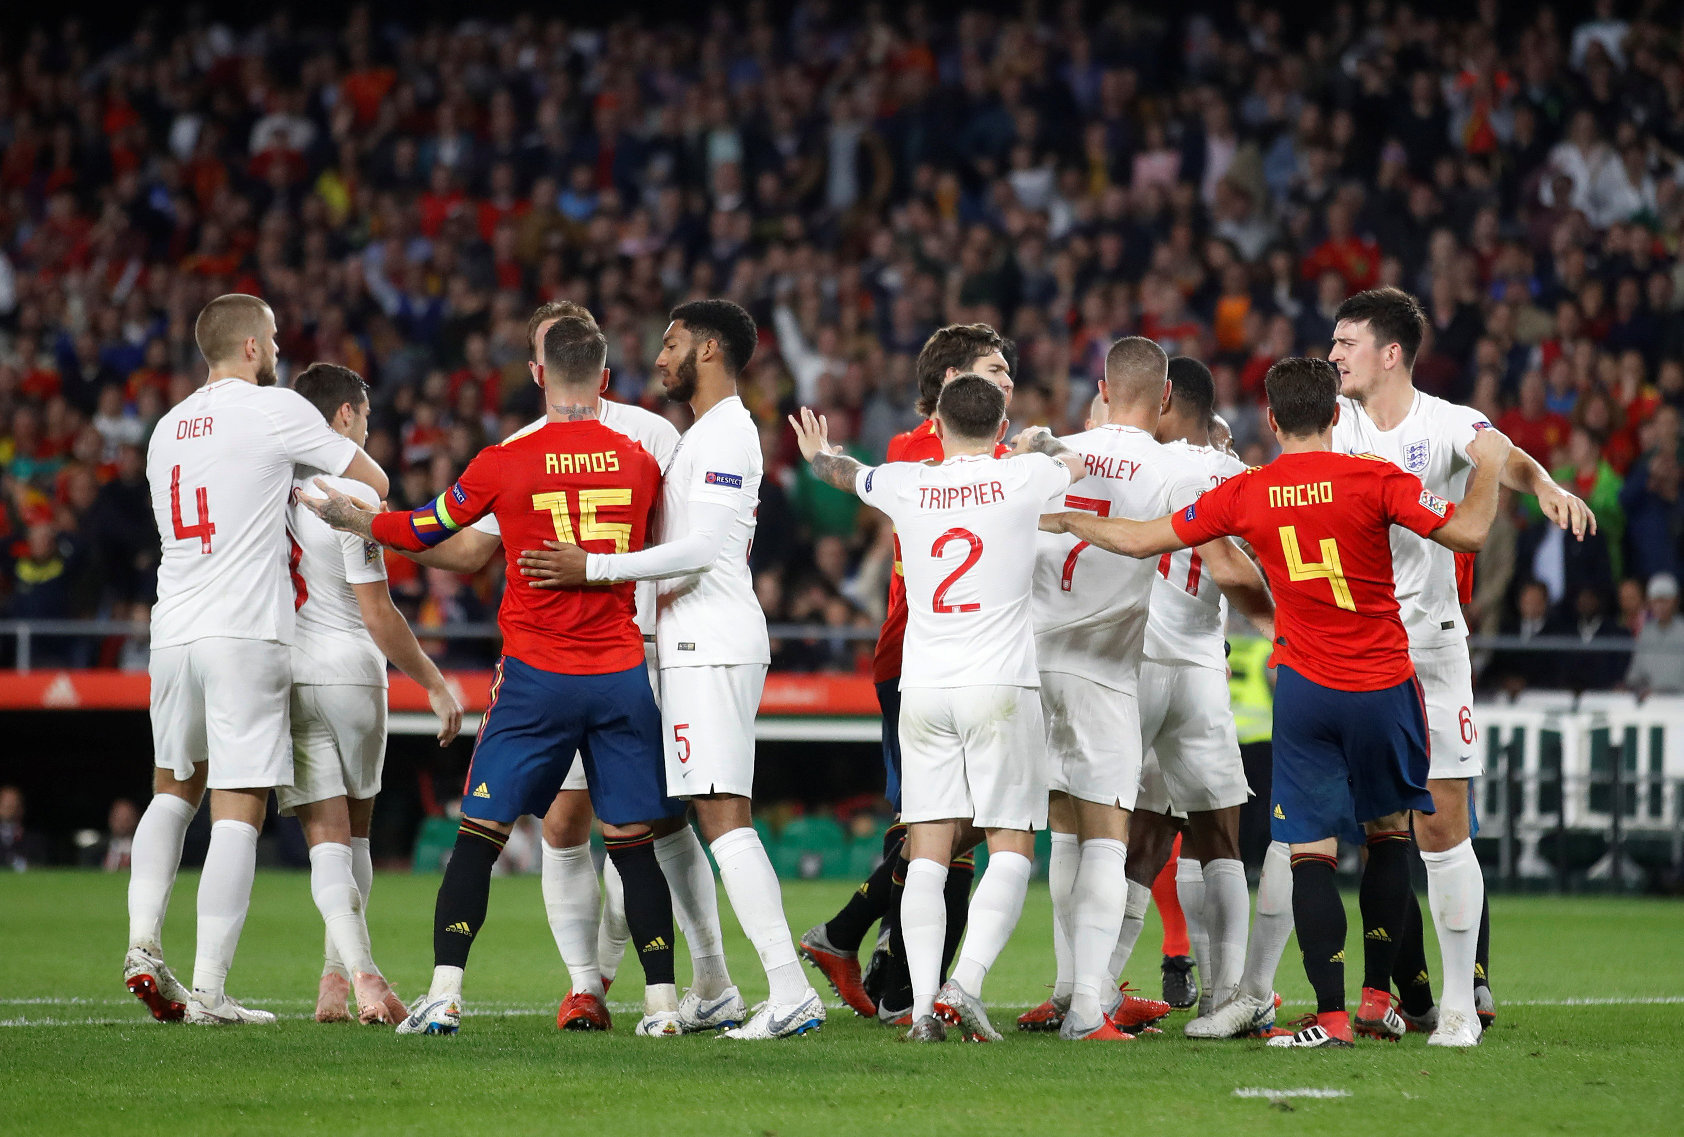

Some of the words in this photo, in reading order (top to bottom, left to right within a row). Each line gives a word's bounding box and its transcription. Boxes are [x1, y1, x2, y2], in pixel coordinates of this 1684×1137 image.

[176, 416, 214, 440] DIER
[545, 450, 620, 474] RAMOS
[1081, 453, 1142, 481] RKLEY
[716, 475, 743, 487] RESPECT
[919, 480, 1006, 510] TRIPPIER
[1268, 481, 1333, 508] NACHO
[170, 464, 216, 554] 4
[532, 488, 633, 585] 15
[1061, 494, 1112, 592] 7
[930, 526, 984, 614] 2
[1277, 525, 1357, 612] 4
[1458, 705, 1473, 745] 6
[673, 723, 691, 764] 5
[642, 944, 669, 953] adidas
